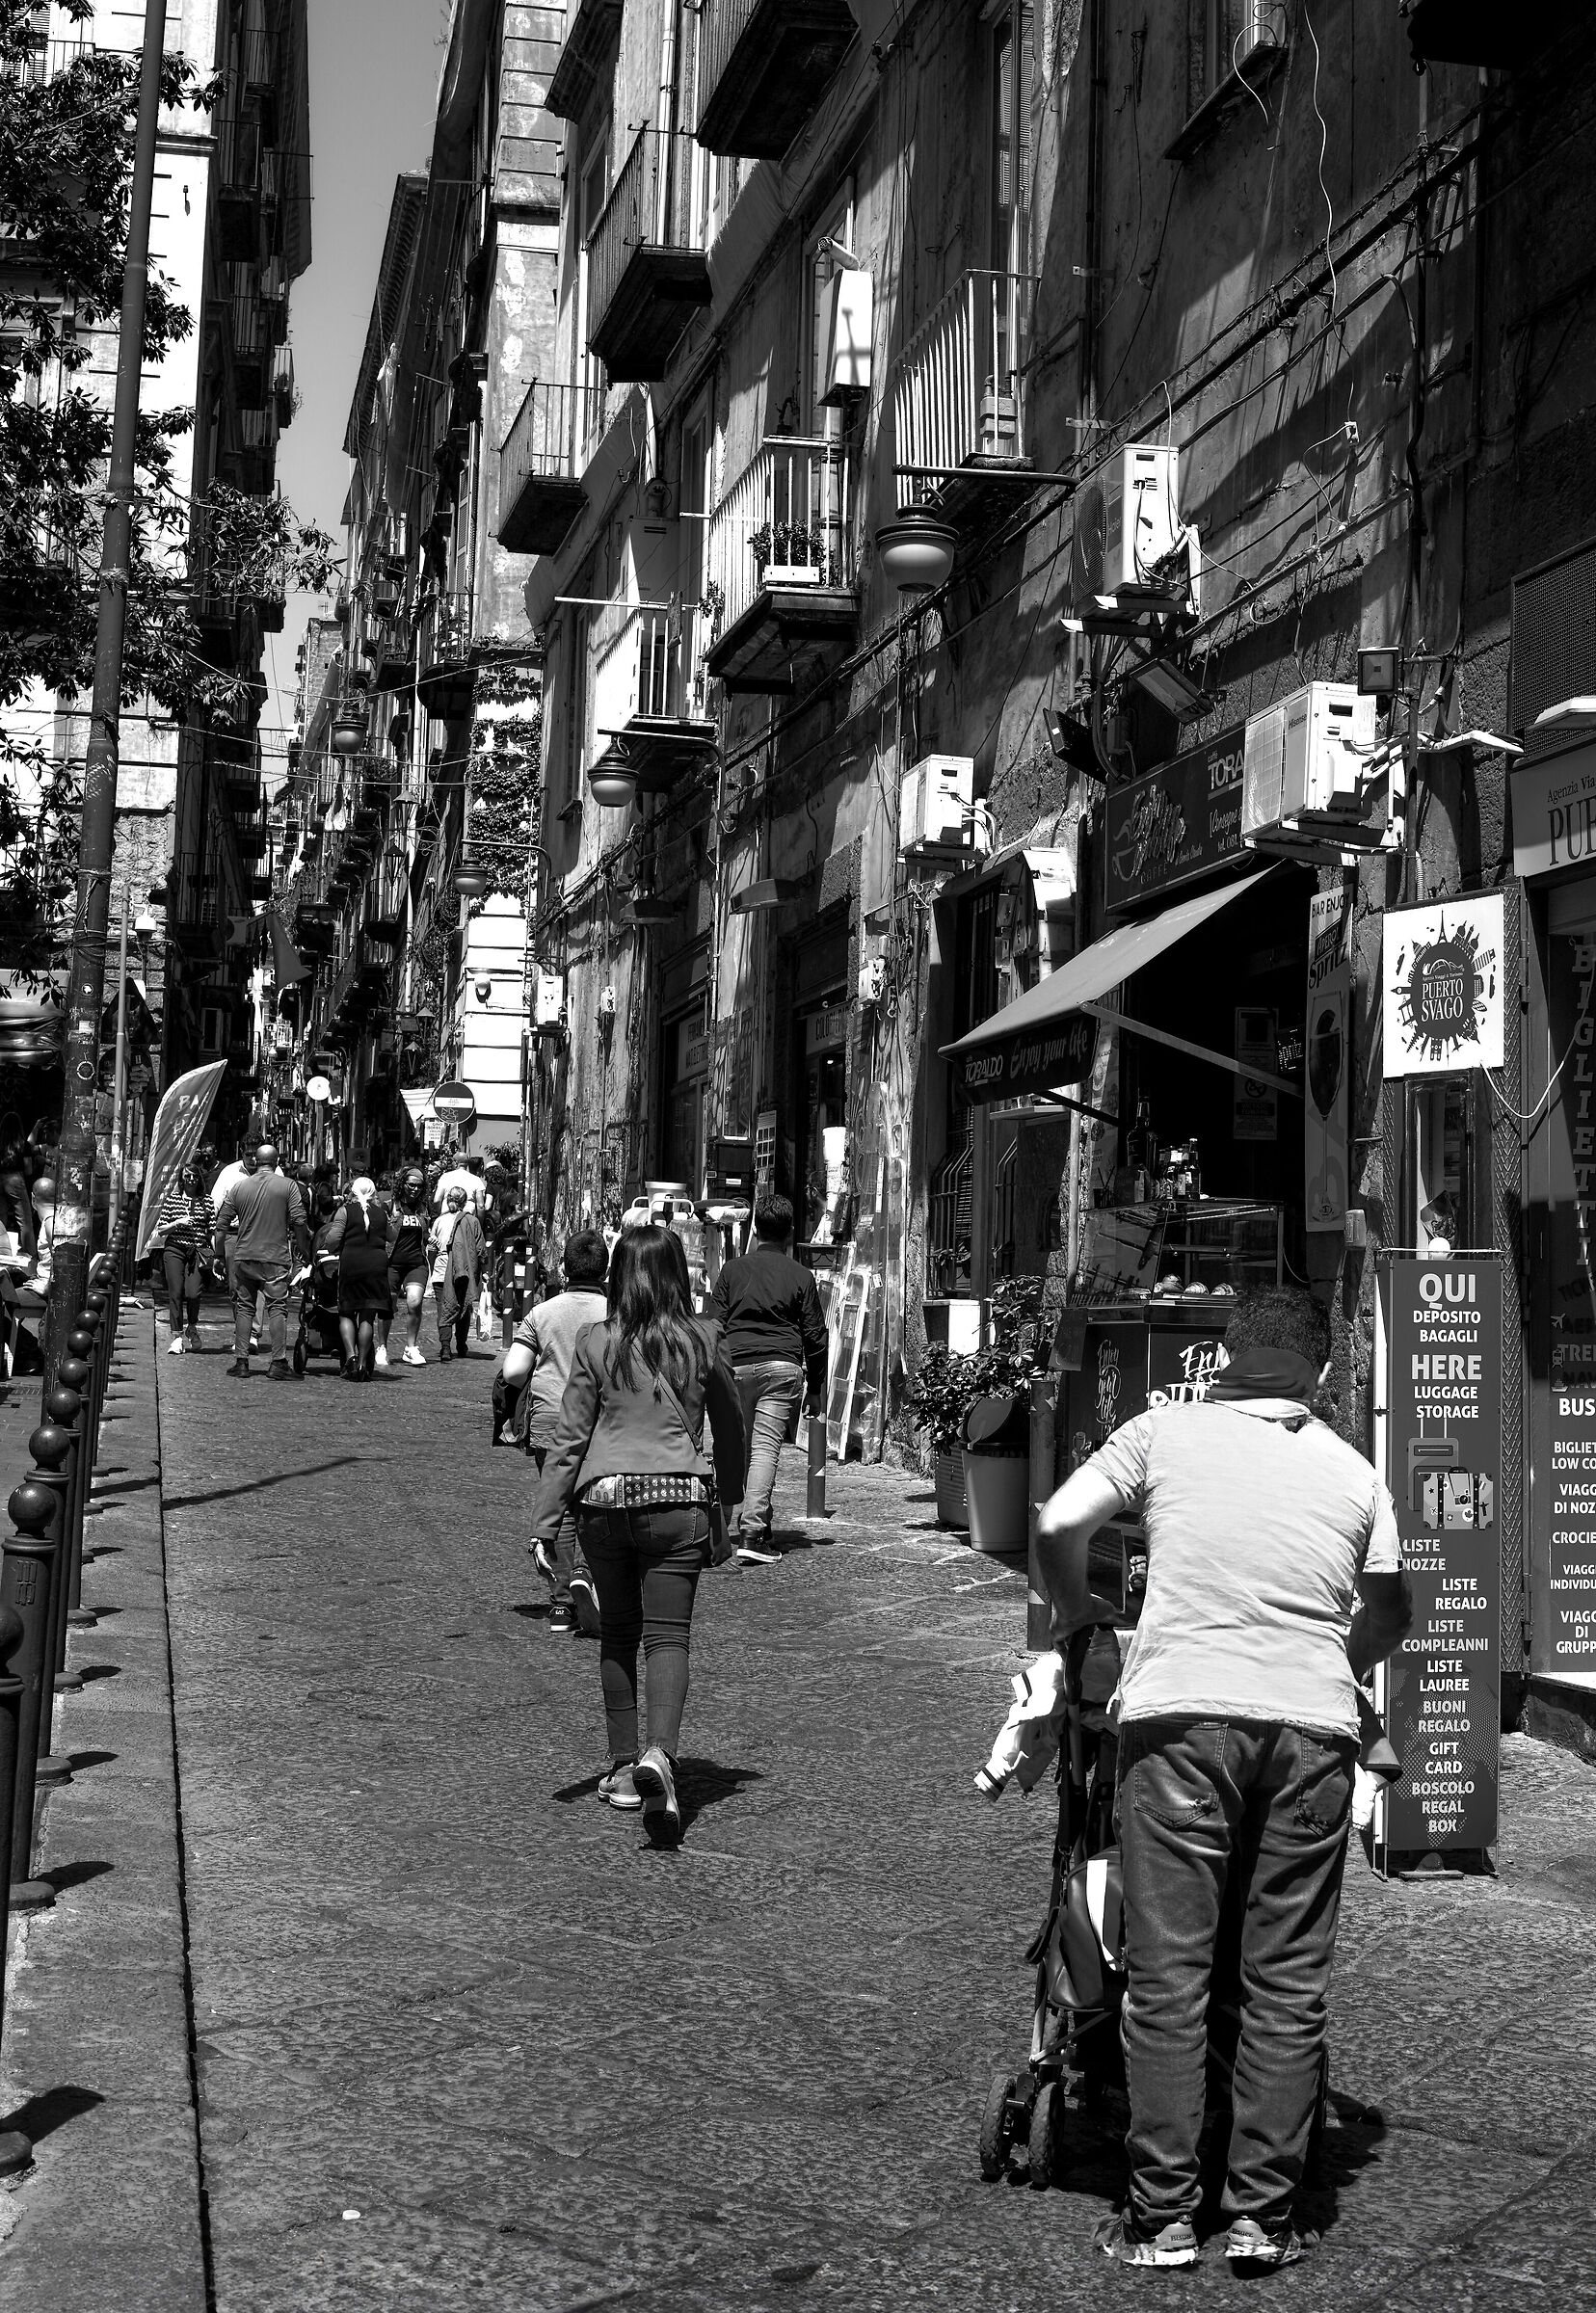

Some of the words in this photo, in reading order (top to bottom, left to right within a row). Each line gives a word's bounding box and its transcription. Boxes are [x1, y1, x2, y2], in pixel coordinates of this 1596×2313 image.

[1208, 749, 1244, 790] TORA
[1547, 781, 1579, 805] Agenzia
[1547, 794, 1596, 866] PUE
[1312, 900, 1324, 917] BAR
[1326, 892, 1350, 914] ENJOY
[1422, 978, 1464, 999] PUERTO
[1422, 996, 1463, 1022] SVAGO
[966, 1054, 1003, 1082] TORALDO
[1010, 1036, 1042, 1079] Enjoy
[1043, 1036, 1066, 1072] your
[1069, 1019, 1088, 1064] life
[1419, 1273, 1476, 1310] QUI
[1413, 1310, 1481, 1324] DEPOSITO
[1420, 1329, 1478, 1343] BAGAGLI
[1411, 1354, 1482, 1380] HERE
[1414, 1385, 1478, 1399] LUGGAGE
[1415, 1404, 1479, 1420] STORAGE
[1558, 1397, 1596, 1417] BUS
[1552, 1458, 1579, 1470] LOW
[1554, 1502, 1567, 1514] DI
[1570, 1502, 1596, 1514] NOZ
[1552, 1531, 1596, 1544] CROCIE
[1402, 1539, 1441, 1552] LISTE
[1402, 1558, 1447, 1571] NOZZE
[1442, 1578, 1477, 1591] LISTE
[1435, 1597, 1487, 1610] REGALO
[1427, 1619, 1464, 1633] LISTE
[1575, 1626, 1588, 1638] DI
[1401, 1637, 1489, 1652] COMPLEANNI
[1556, 1640, 1596, 1654] GRUPP
[1426, 1660, 1463, 1672] LISTE
[1420, 1679, 1470, 1691] LAUREE
[1423, 1700, 1466, 1714] BUONI
[1418, 1719, 1471, 1733] REGALO
[1429, 1741, 1459, 1755] GIFT
[1424, 1761, 1463, 1773] CARD
[1412, 1781, 1475, 1795] BOSCOLO
[1422, 1800, 1465, 1814] REGAL
[1428, 1819, 1457, 1832] BOX
